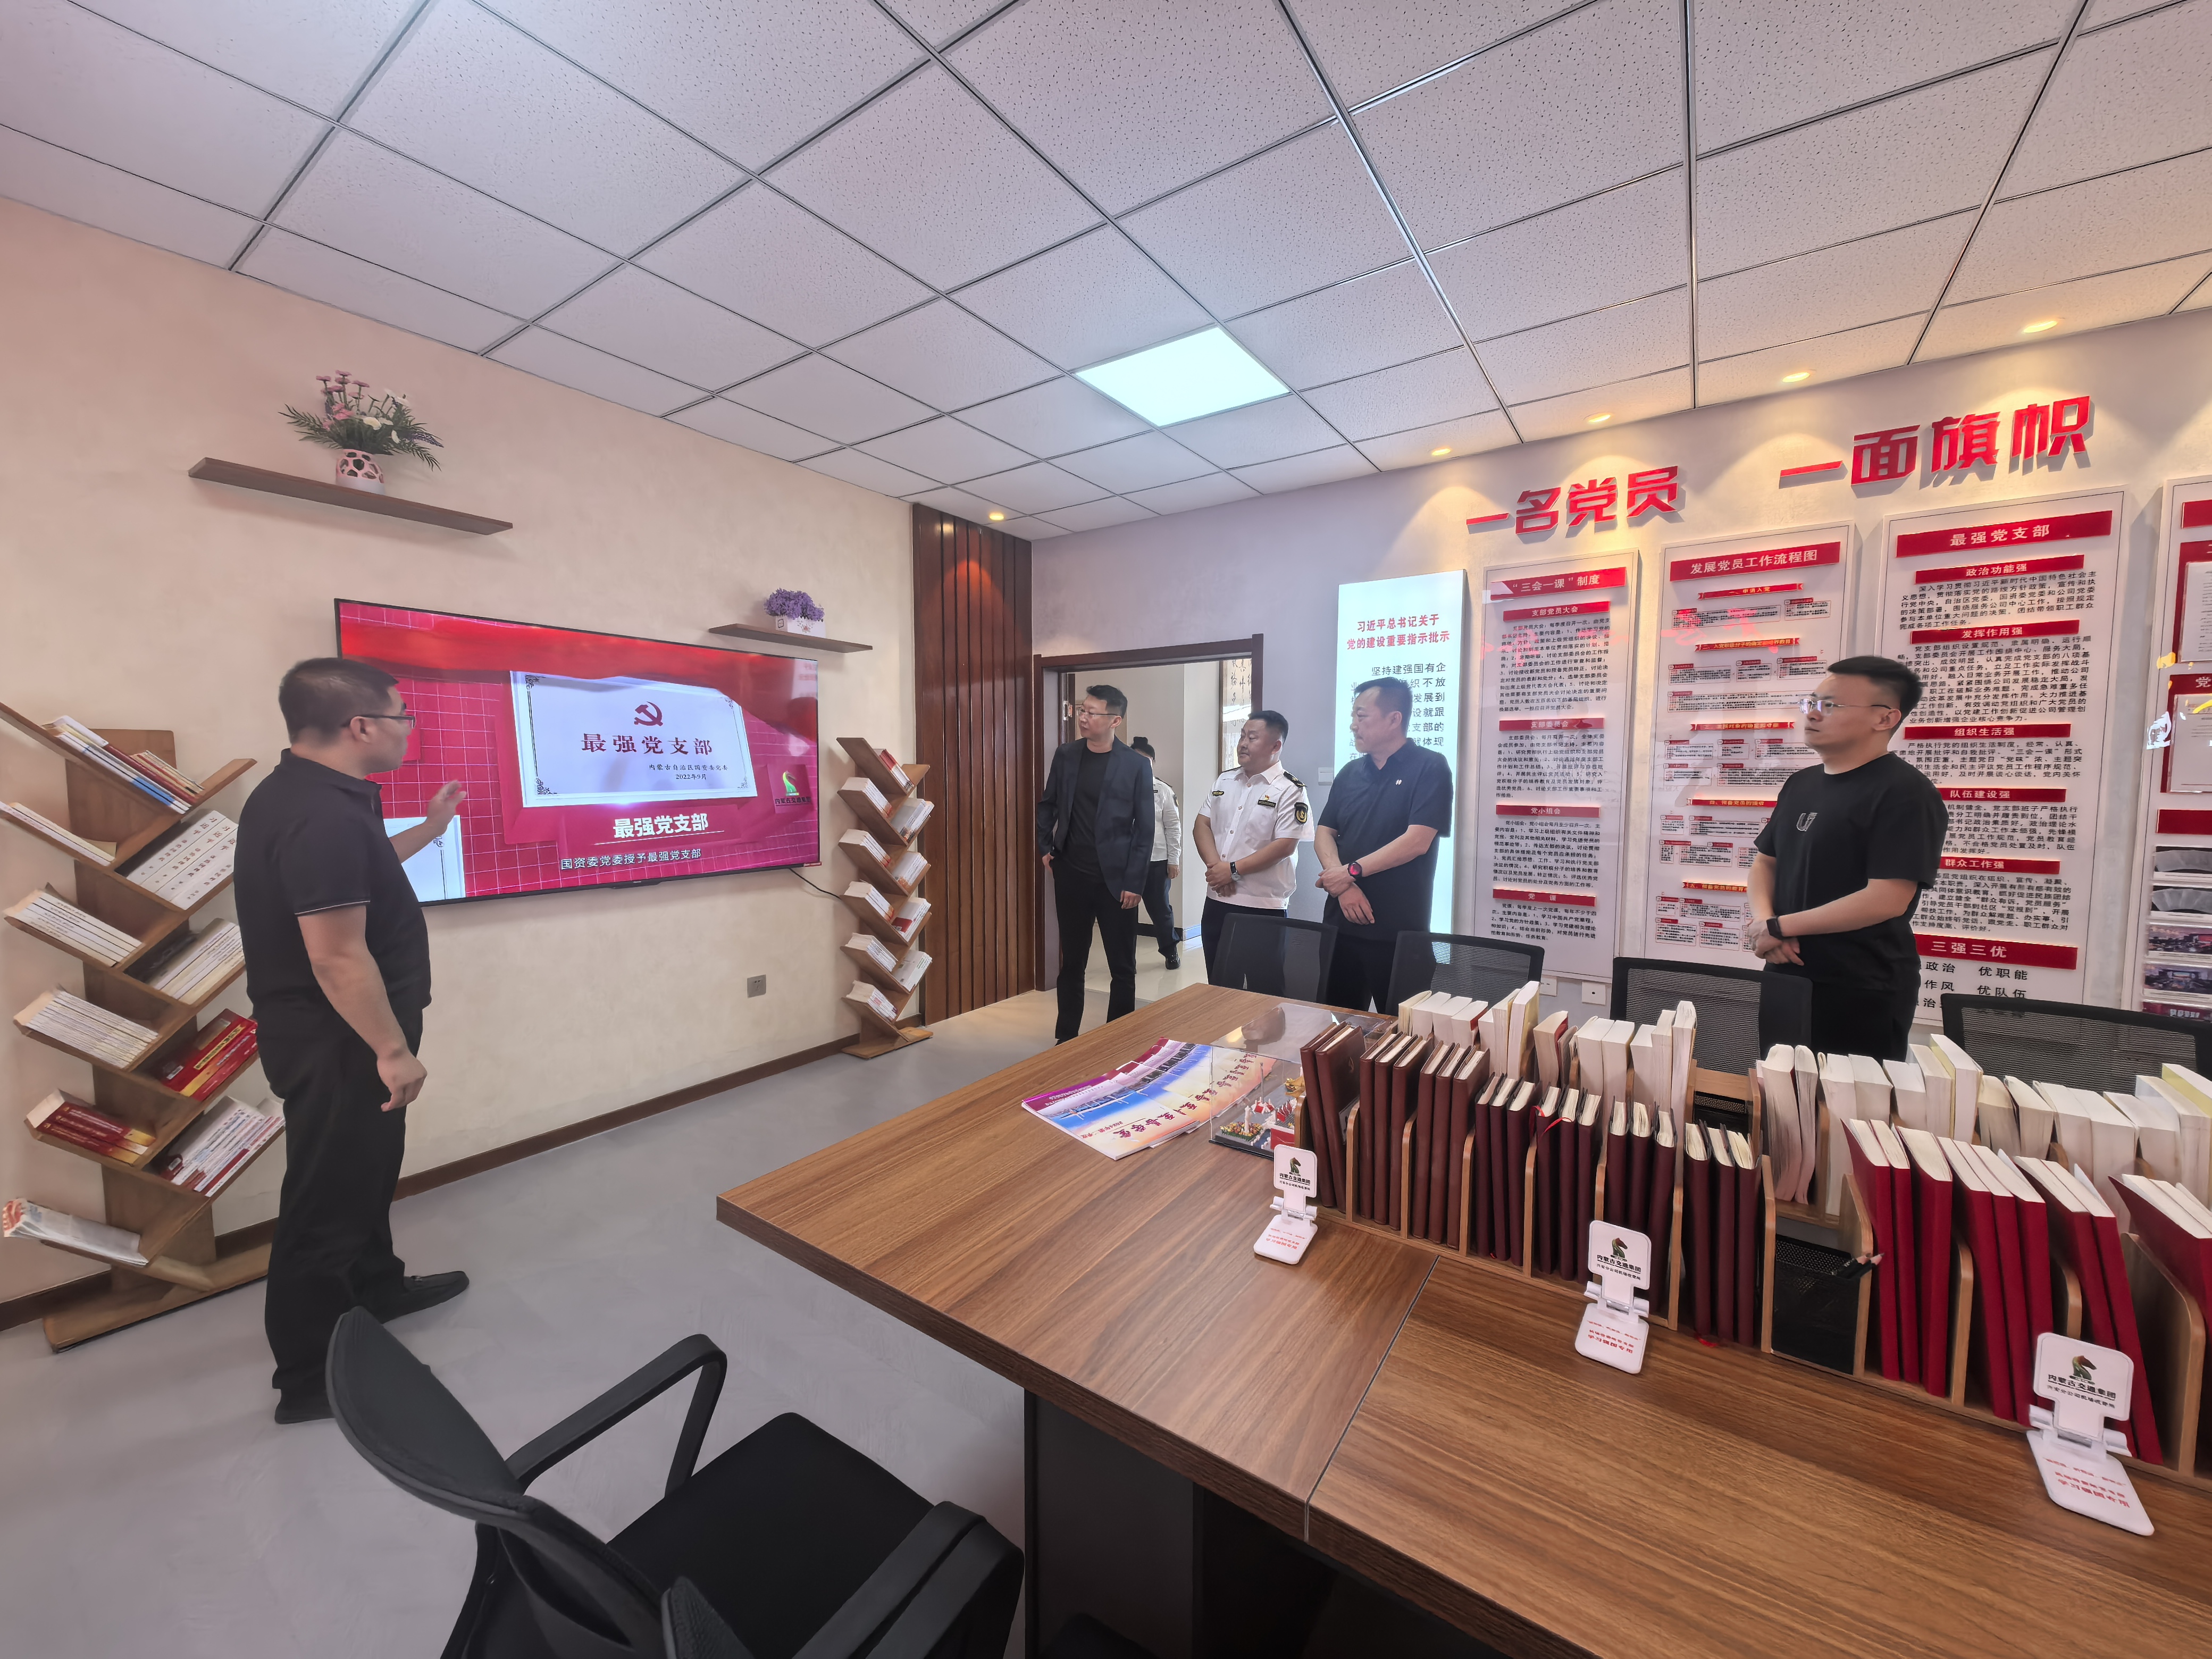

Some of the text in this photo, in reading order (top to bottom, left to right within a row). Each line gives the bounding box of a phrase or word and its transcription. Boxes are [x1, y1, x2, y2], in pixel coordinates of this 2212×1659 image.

[1780, 396, 2090, 485] 一面旗帜
[1466, 466, 1679, 534] 一名党员
[1950, 525, 2050, 546] 最强党支部
[1690, 550, 1817, 574] 发展党员工作流程图
[1966, 564, 2027, 576] 政治功能强
[1532, 606, 1578, 616] 支部党员大会
[1358, 614, 1439, 632] 习近平总书记关于
[1347, 631, 1450, 650] 党的建设重要指示批示
[1962, 627, 2023, 638] 发挥作用强
[1371, 663, 1446, 676] 坚持建强国有企
[1412, 692, 1445, 702] 发展到
[1413, 707, 1444, 717] 设就跟
[1409, 722, 1444, 732] 支部的
[1531, 720, 1569, 728] 支部委员会
[1954, 727, 2015, 736] 组织生活强
[581, 733, 713, 755] 最强党支部
[1950, 790, 2010, 799] 队伍建设强
[1531, 807, 1561, 815] 党小组会
[613, 814, 708, 839] 最强党支部
[561, 849, 701, 870] 国资委党委授予最强党支部
[1945, 859, 2004, 869] 群众工作强
[1931, 941, 2007, 958] 三强三优
[1920, 961, 2028, 980] 政治 优职能
[1924, 979, 2027, 999] 作风 优队伍
[1113, 1111, 1175, 1139] 至善学堂
[1279, 1172, 1310, 1184] 内蒙古交通集团
[1597, 1254, 1640, 1272] 内蒙古交通集团
[2048, 1374, 2116, 1399] 内蒙古交通集团
